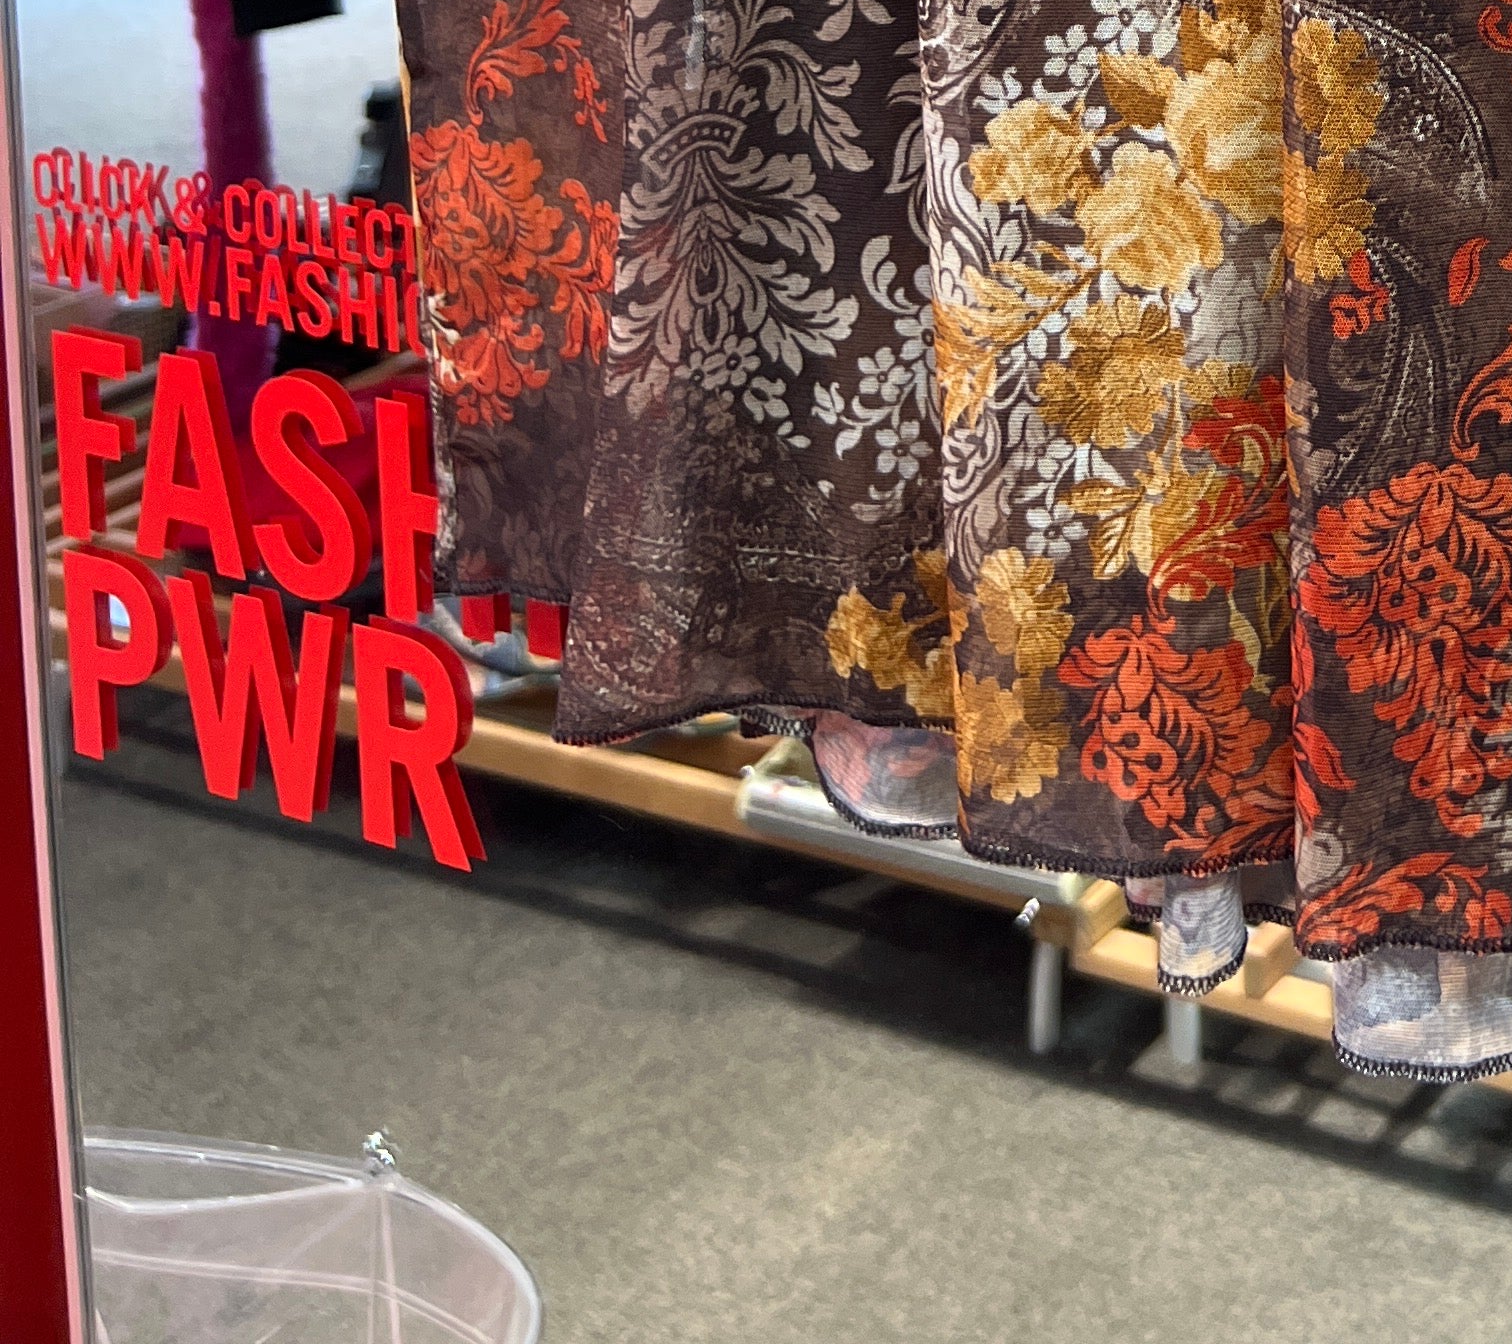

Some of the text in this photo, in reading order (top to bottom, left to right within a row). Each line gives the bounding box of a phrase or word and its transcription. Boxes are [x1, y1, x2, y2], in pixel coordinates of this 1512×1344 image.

[33, 151, 416, 274] CLICK & COLLECT
[54, 330, 562, 660] FASH
[63, 550, 472, 872] PWR
